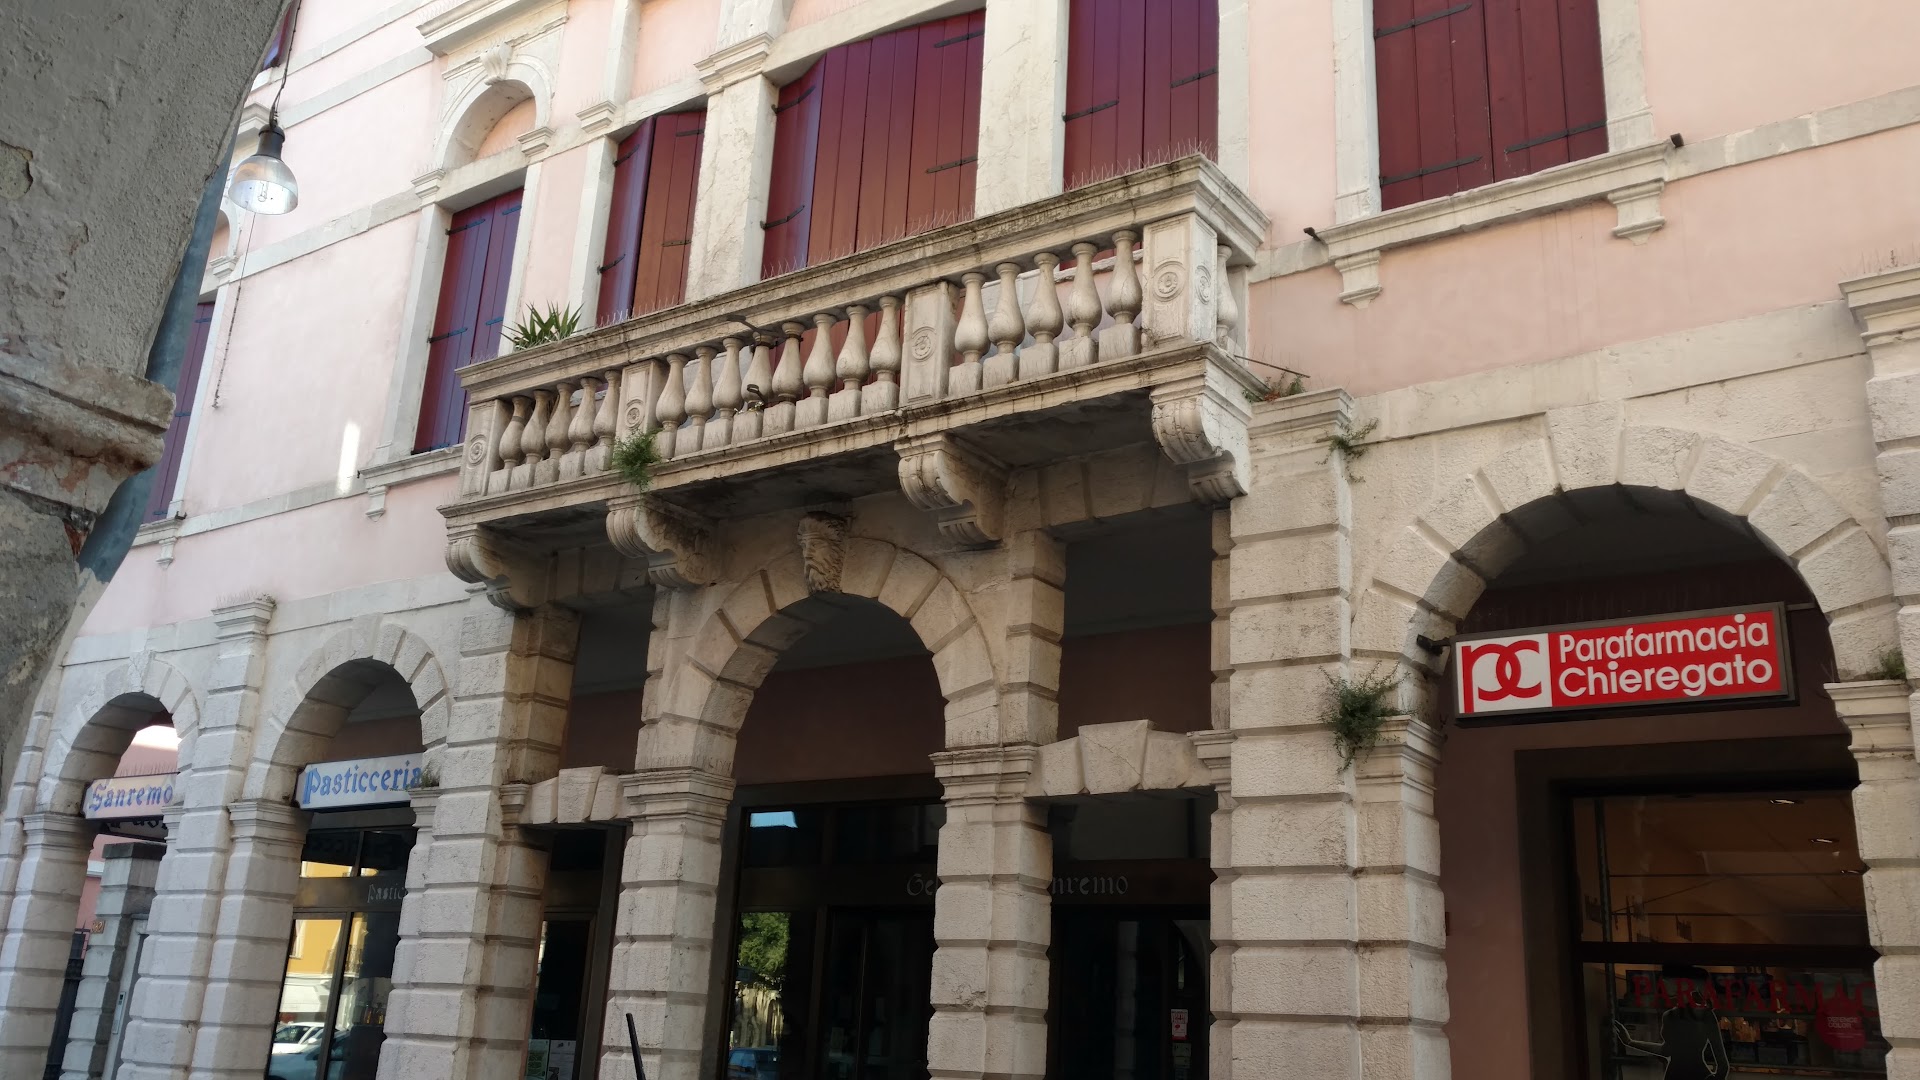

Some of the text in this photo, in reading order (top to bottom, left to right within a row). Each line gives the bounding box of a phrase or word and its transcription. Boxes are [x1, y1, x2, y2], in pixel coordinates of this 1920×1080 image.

[1559, 614, 1770, 663] Parafarmacia
[1558, 654, 1773, 697] Chieregato
[88, 783, 174, 812] Sanremo
[302, 760, 422, 804] Pasticceria
[367, 883, 408, 904] Pastic
